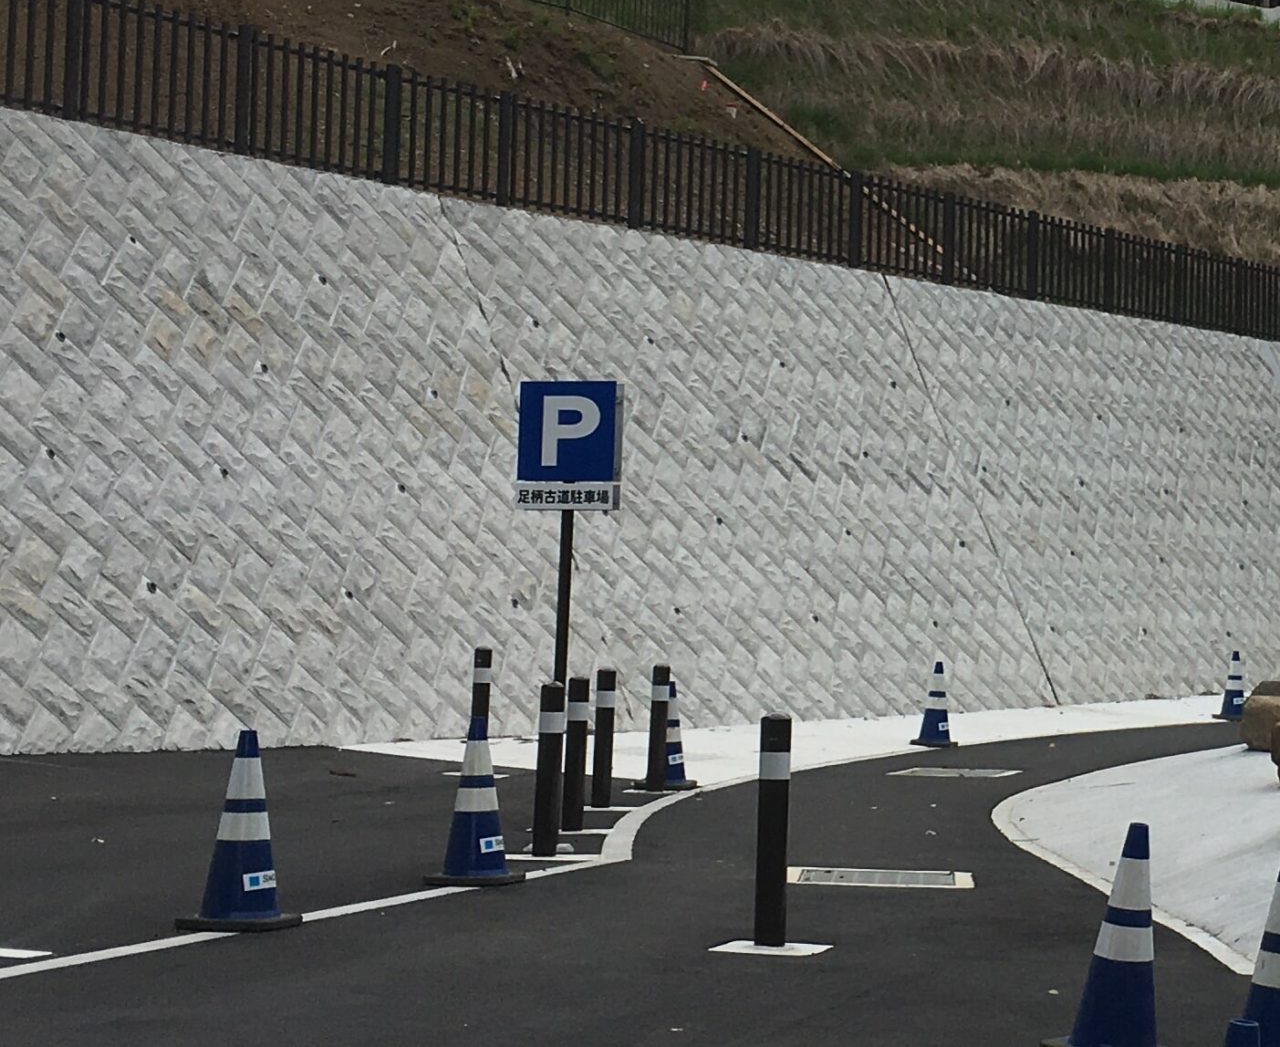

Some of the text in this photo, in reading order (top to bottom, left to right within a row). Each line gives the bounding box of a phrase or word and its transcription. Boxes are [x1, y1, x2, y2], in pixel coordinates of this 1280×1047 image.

[541, 395, 601, 467] P
[518, 489, 610, 505] 足柄古道駐車場
